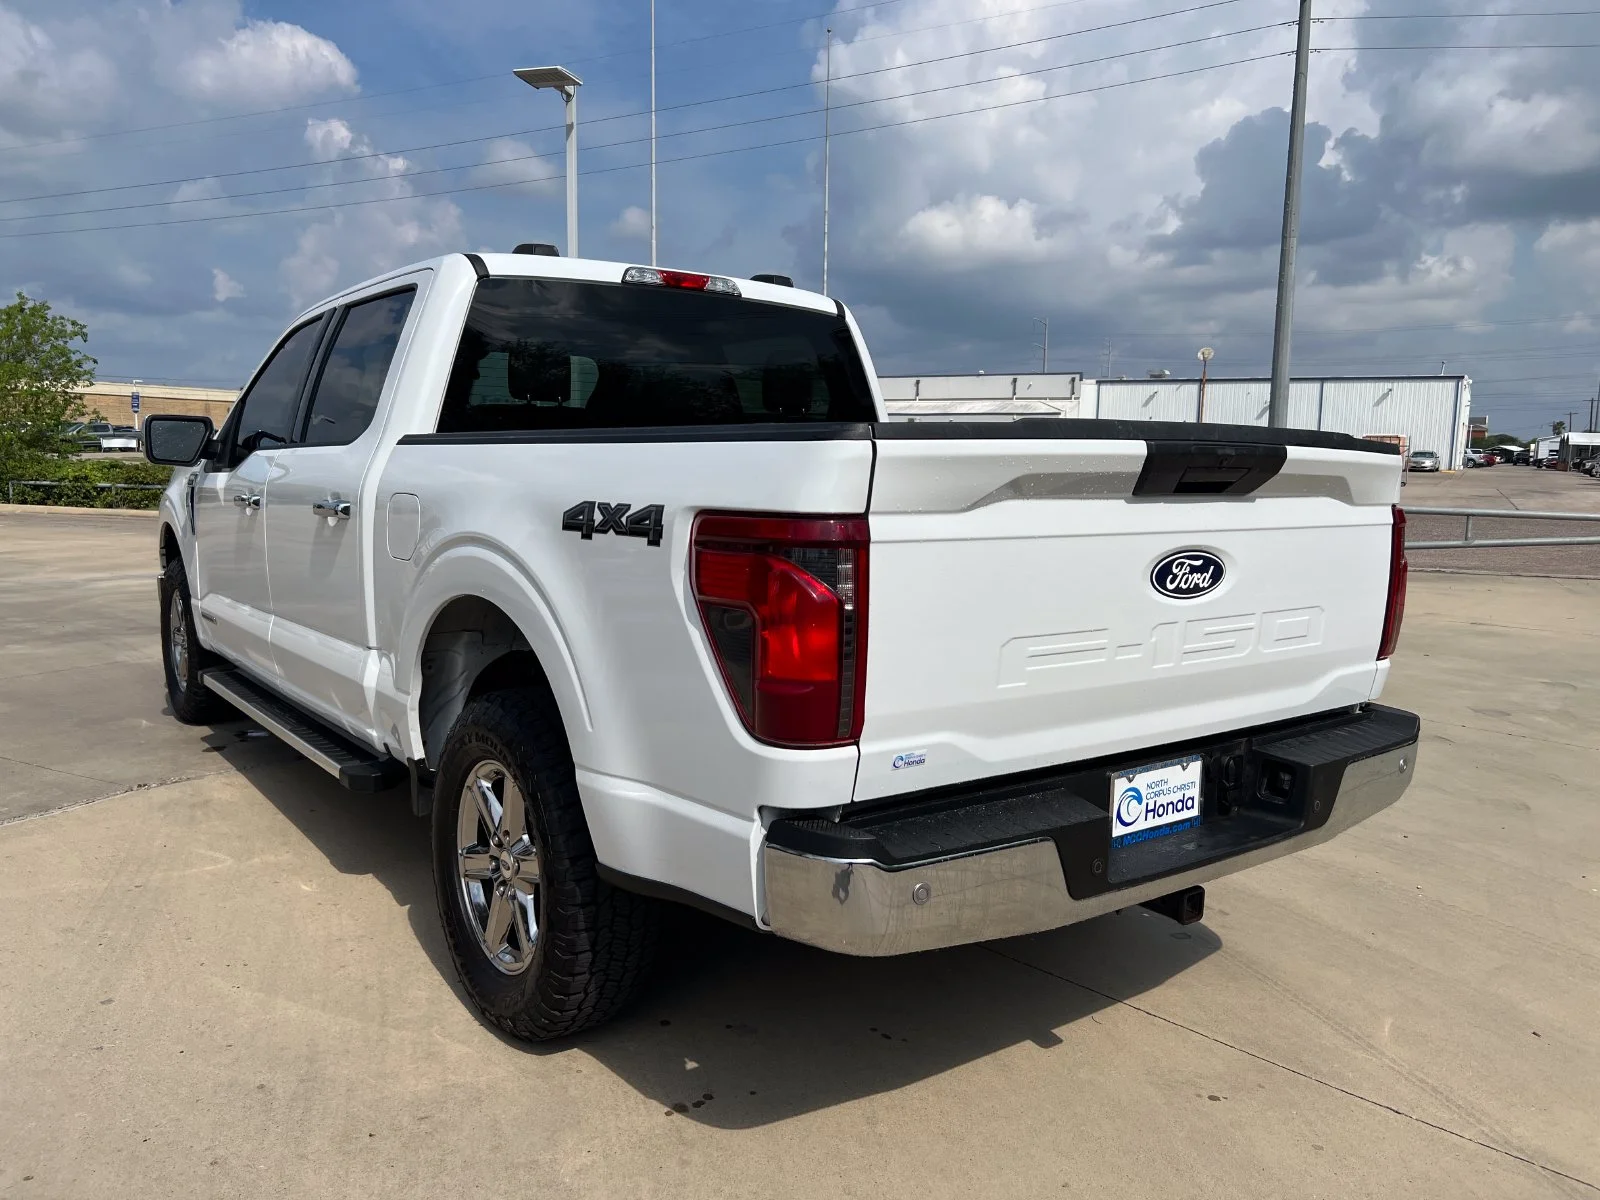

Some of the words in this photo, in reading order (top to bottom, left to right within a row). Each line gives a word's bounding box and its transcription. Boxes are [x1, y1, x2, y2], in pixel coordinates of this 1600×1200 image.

[1166, 558, 1213, 590] Ford
[997, 606, 1325, 688] F-150
[903, 757, 925, 767] Honda
[1145, 787, 1172, 801] CORPUS
[1172, 781, 1196, 793] CHRISTI
[1146, 778, 1168, 790] NORTH
[1145, 793, 1194, 821] Honda
